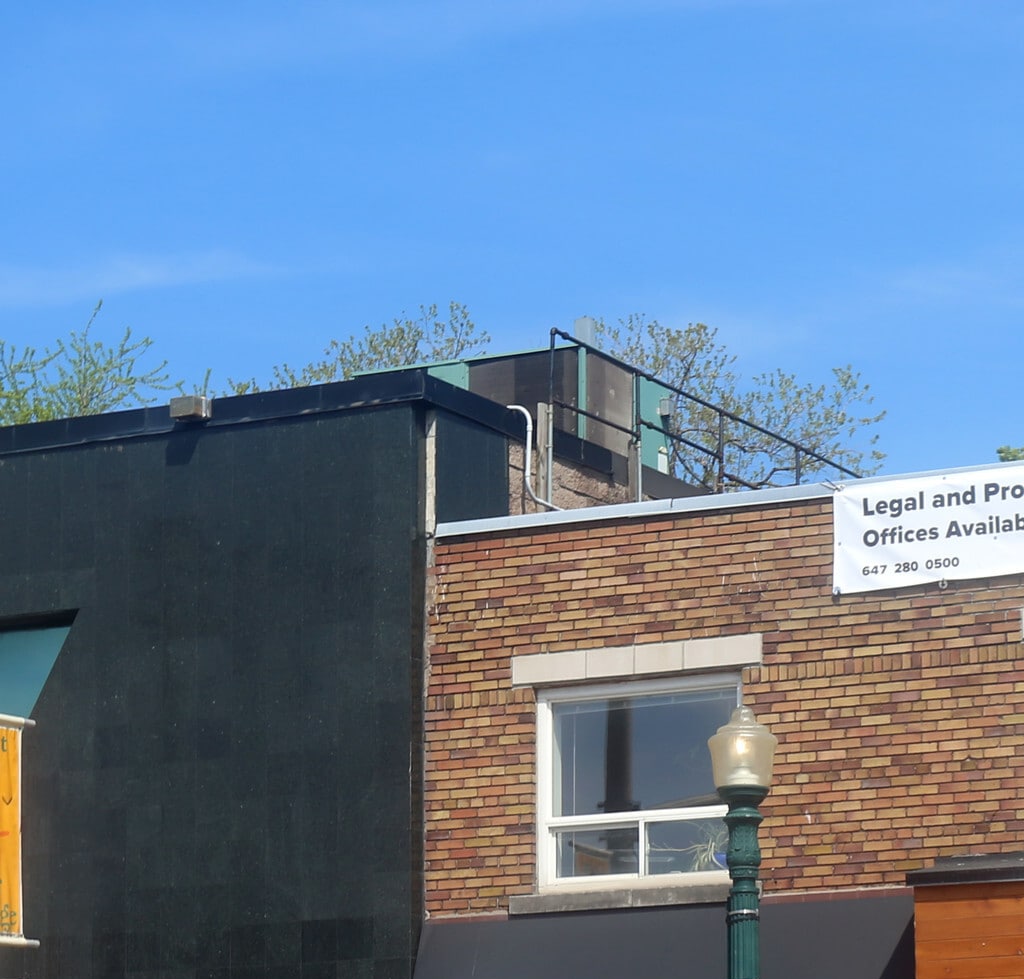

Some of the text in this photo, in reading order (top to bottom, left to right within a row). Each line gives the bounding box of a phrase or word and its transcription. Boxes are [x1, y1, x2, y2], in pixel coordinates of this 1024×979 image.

[863, 491, 925, 518] Legal
[932, 486, 976, 509] and
[863, 524, 939, 548] Offices
[862, 557, 960, 576] 647 280 0500
